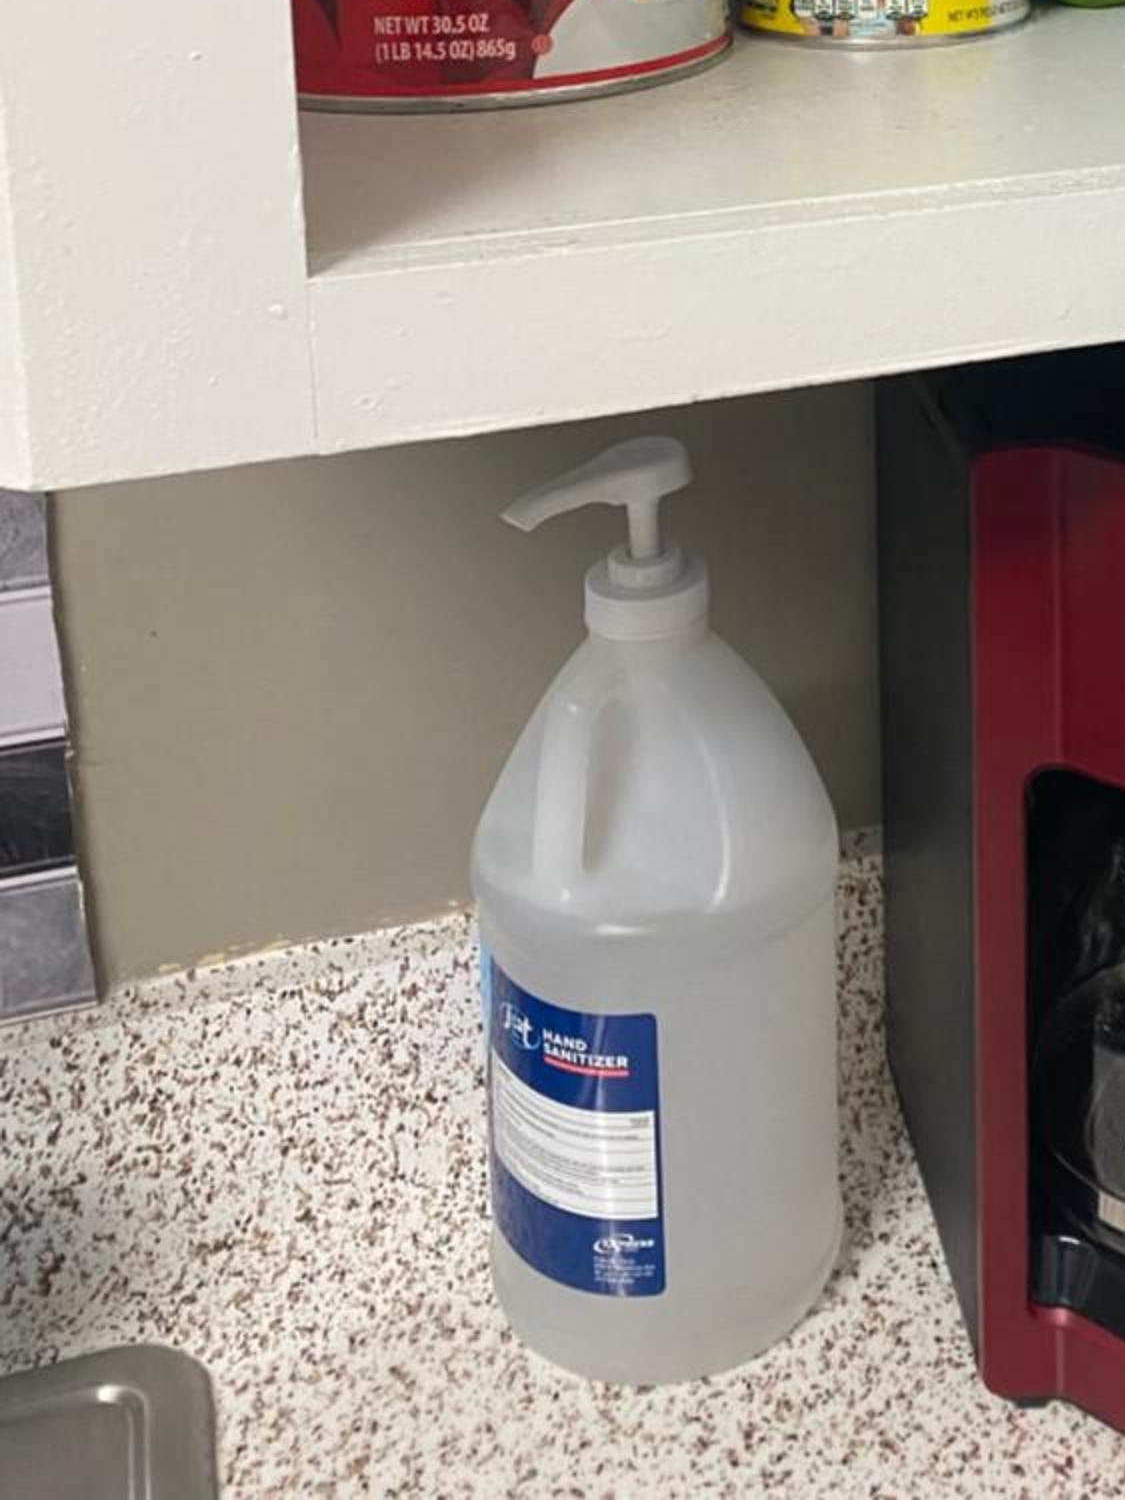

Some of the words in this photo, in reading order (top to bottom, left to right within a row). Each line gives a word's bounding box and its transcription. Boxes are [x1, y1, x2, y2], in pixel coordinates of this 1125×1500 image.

[373, 16, 401, 35] NET
[404, 15, 430, 35] WT
[431, 14, 467, 35] 30.5
[467, 12, 490, 33] OZ
[391, 41, 412, 61] LB
[414, 41, 447, 61] 14.5
[449, 39, 475, 62] OZ)
[476, 37, 517, 61] 865g
[542, 1027, 588, 1052] HAND
[543, 1041, 629, 1068] SANITIZER
